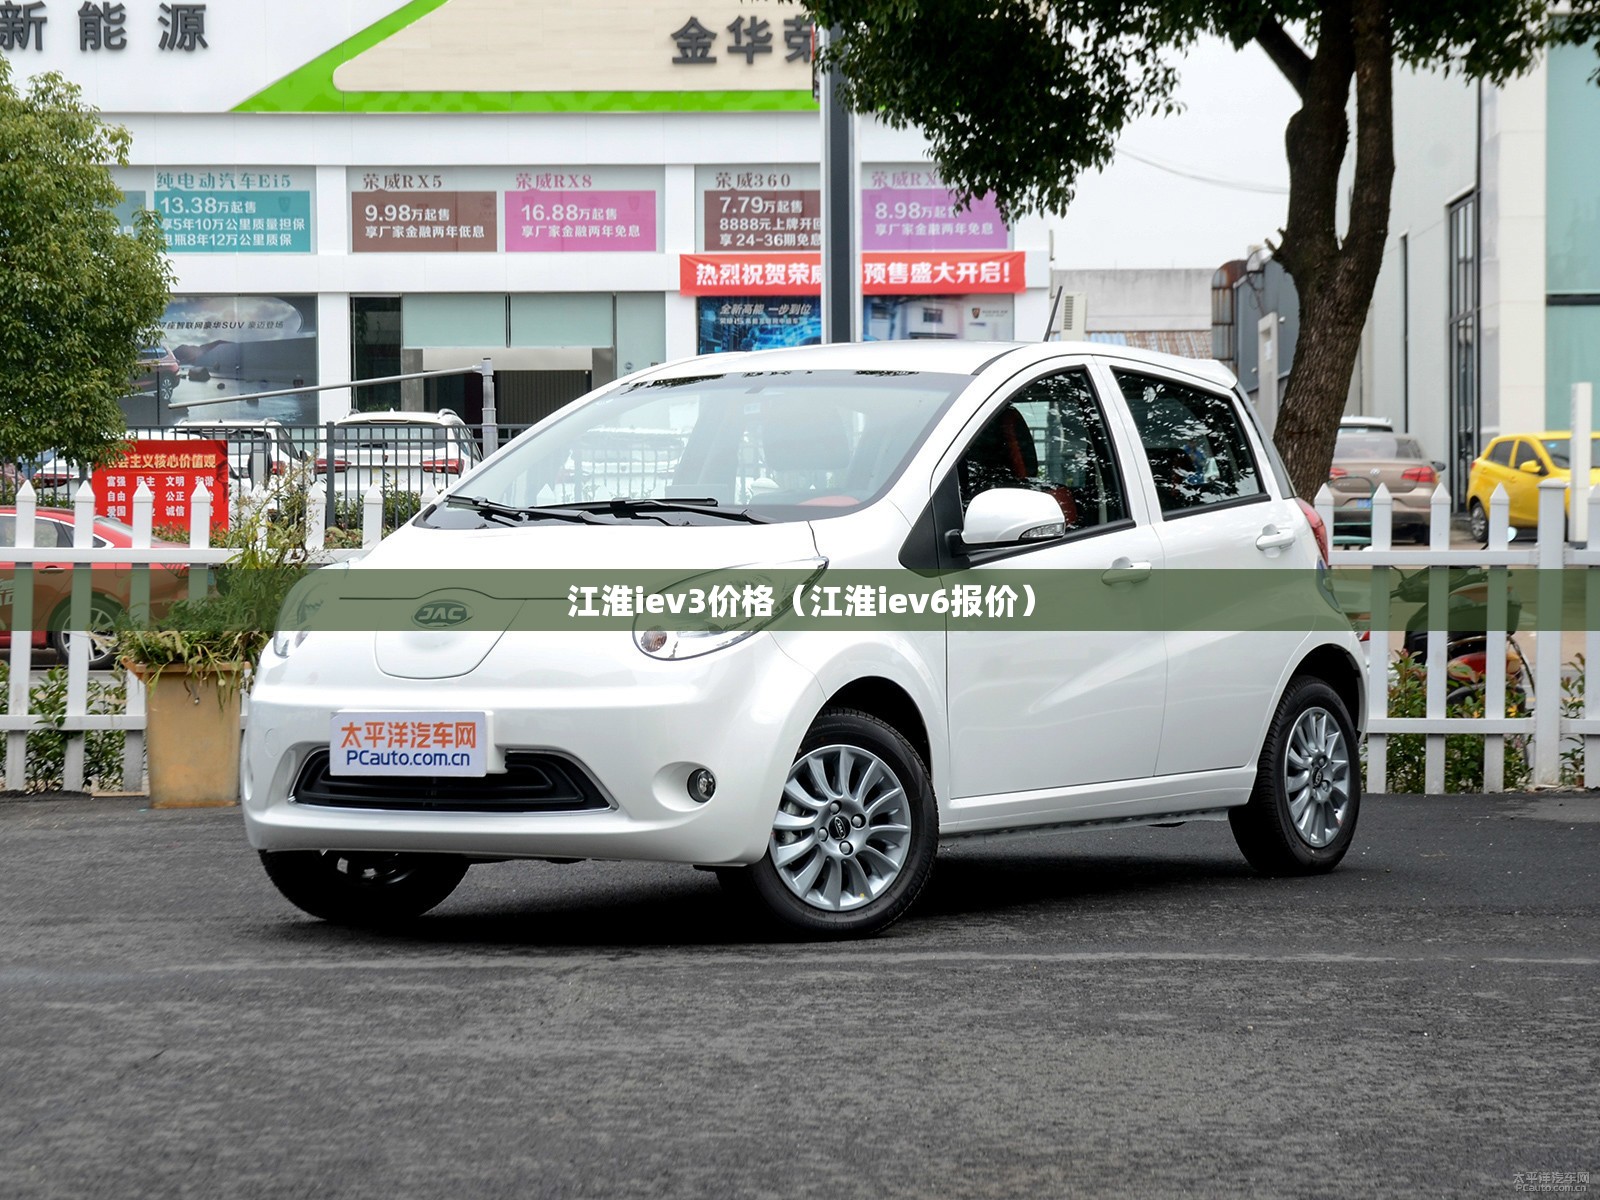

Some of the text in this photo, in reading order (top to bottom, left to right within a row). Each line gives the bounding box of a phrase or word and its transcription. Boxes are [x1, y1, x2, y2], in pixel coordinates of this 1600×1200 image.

[0, 1, 209, 52] 新能源
[157, 172, 291, 190] 纯电动汽车Ei5
[363, 173, 442, 190] 荣威RX5
[516, 173, 592, 190] 荣威RX8
[715, 172, 791, 188] 荣威360
[872, 171, 944, 187] 荣威RX
[160, 197, 256, 214] 13.38万起售
[365, 204, 450, 222] 9.98万起售
[521, 204, 617, 222] 16.88万起售
[720, 196, 802, 214] 7.79万起售
[365, 225, 485, 239] 享厂家金融两年低息
[521, 225, 640, 239] 享厂家金融两年免息
[875, 222, 993, 236] 享厂家金融两年免息
[107, 476, 126, 487] 富强
[166, 476, 185, 487] 文明
[107, 491, 126, 502] 自由
[166, 491, 185, 502] 公正
[107, 506, 126, 517] 爱国
[166, 506, 185, 517] 诚信
[418, 607, 465, 620] JAC
[341, 721, 477, 749] 太平洋汽车网
[346, 750, 471, 766] PCauto.com.cn
